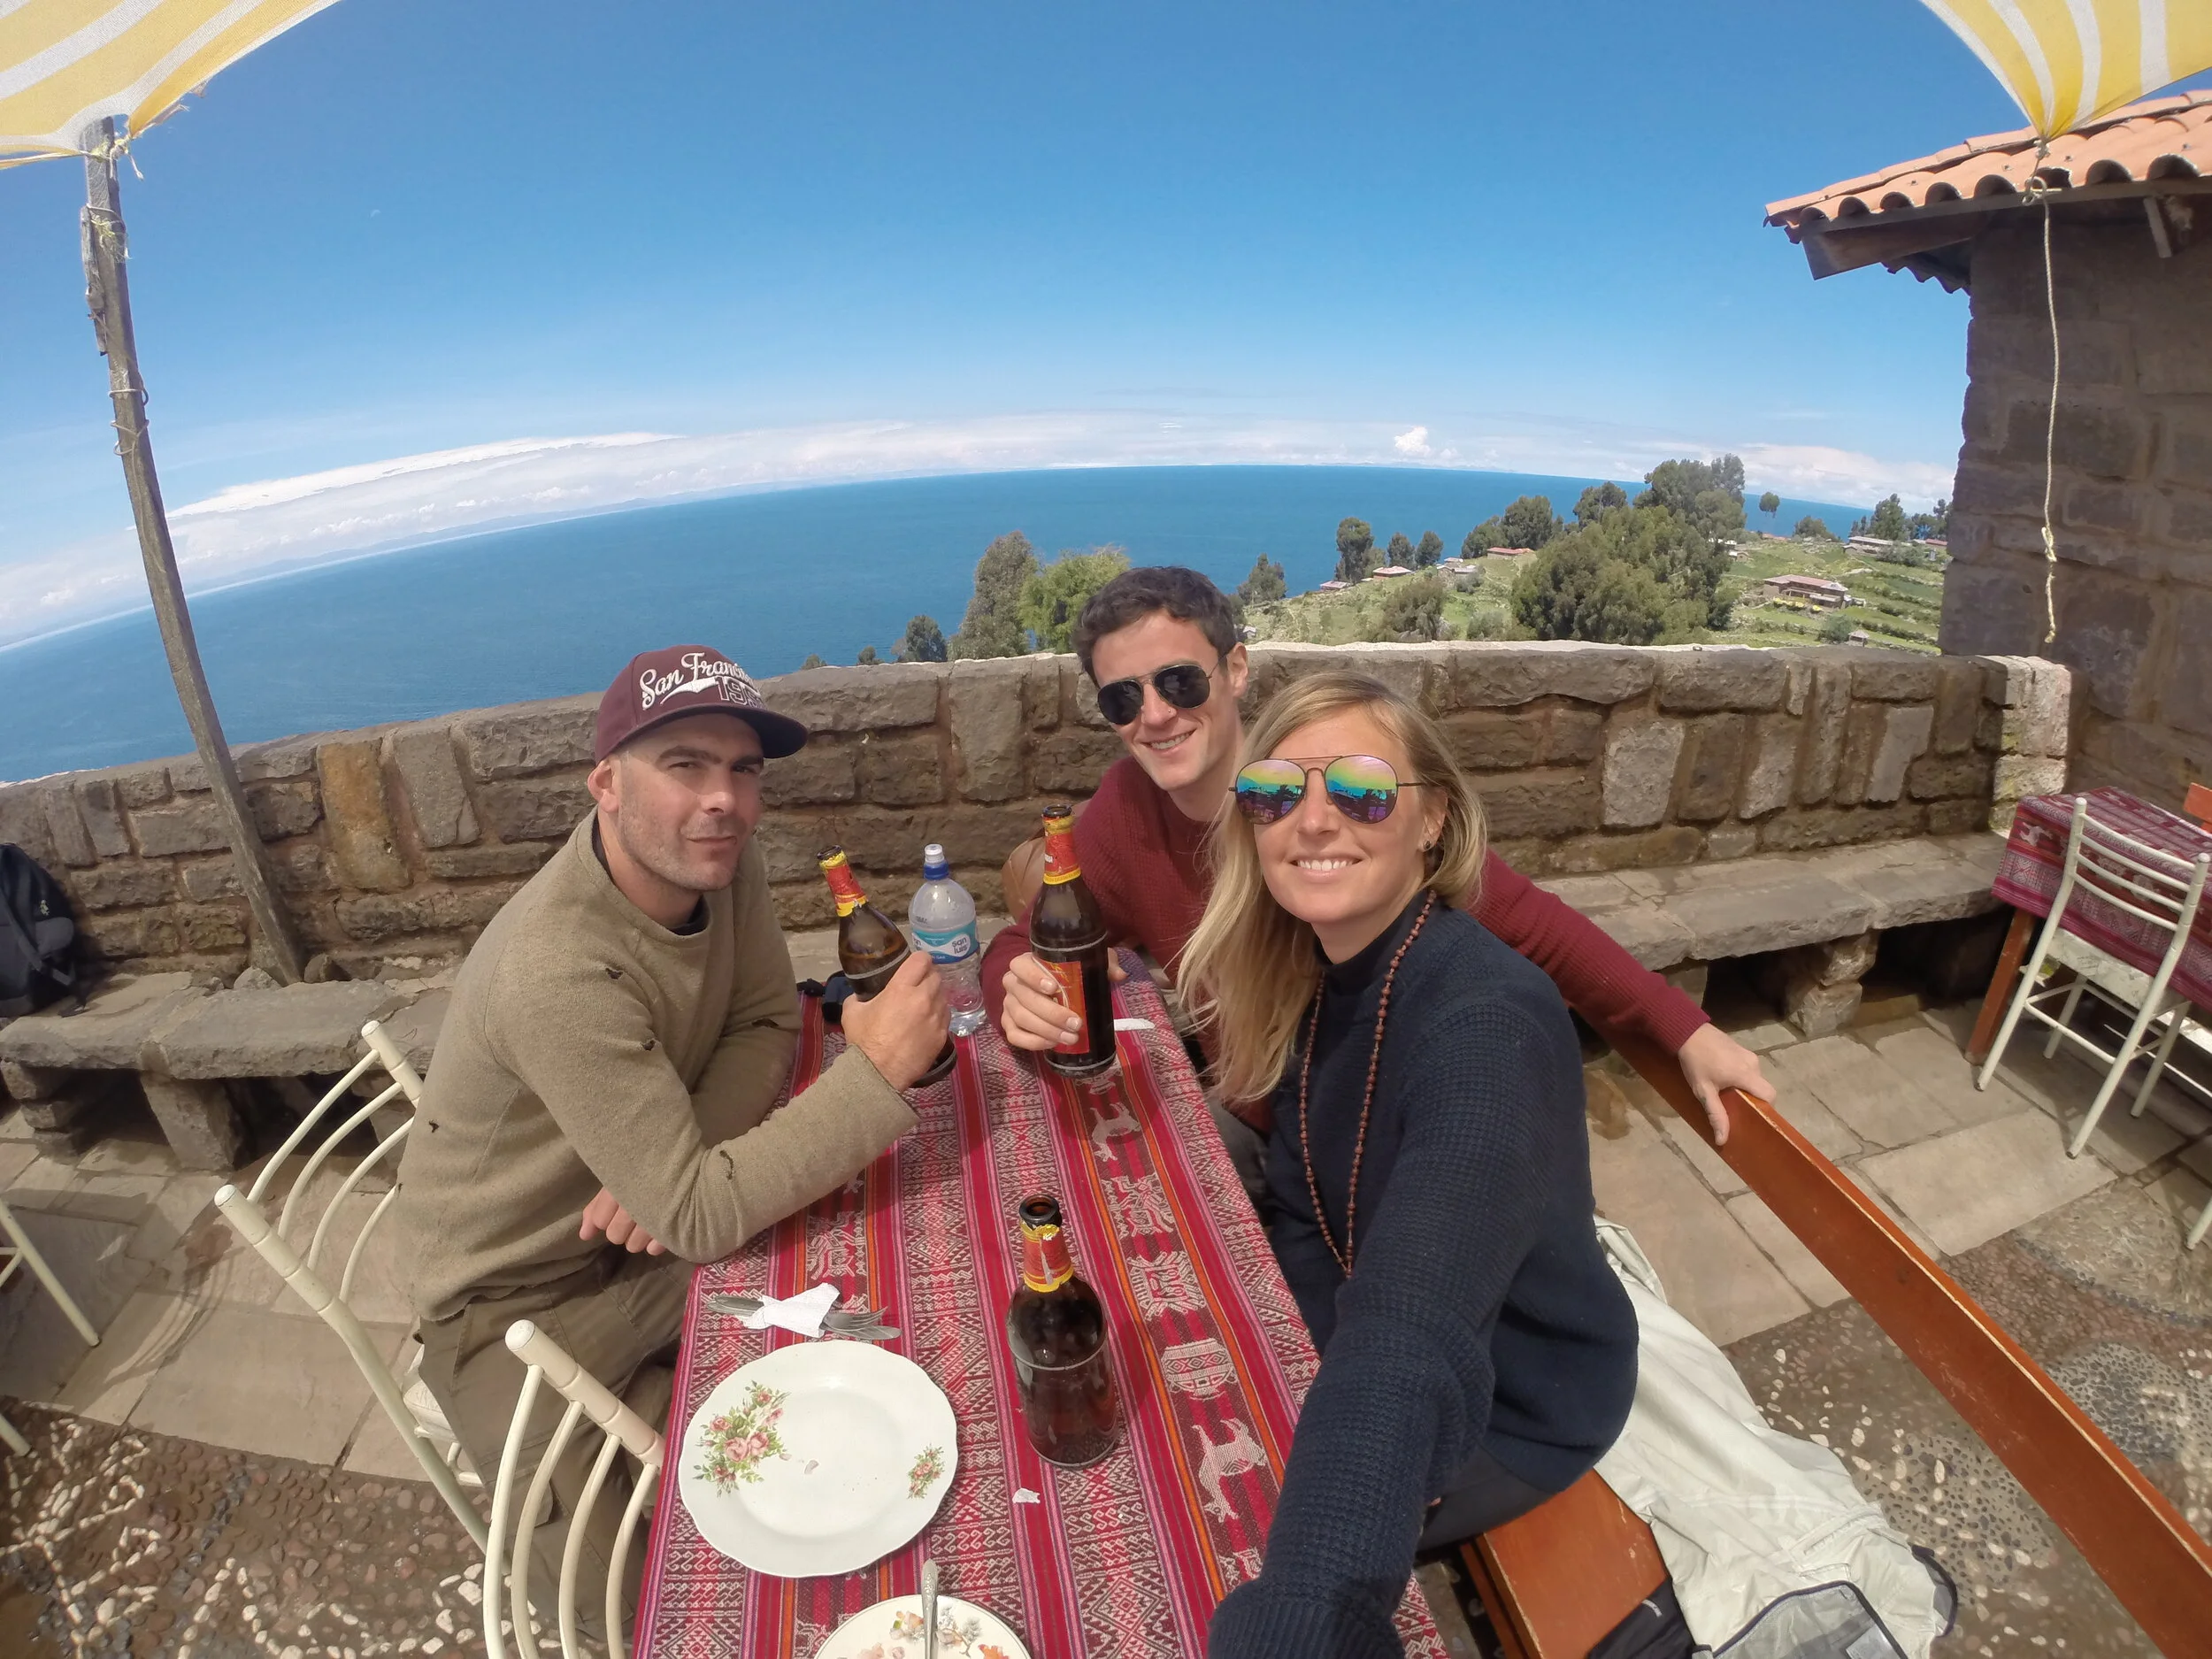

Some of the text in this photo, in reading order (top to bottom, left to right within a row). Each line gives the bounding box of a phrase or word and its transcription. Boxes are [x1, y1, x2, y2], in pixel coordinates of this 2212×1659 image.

[640, 652, 754, 710] San Franci
[716, 676, 763, 709] 19
[952, 937, 967, 948] san
[954, 945, 968, 954] luis
